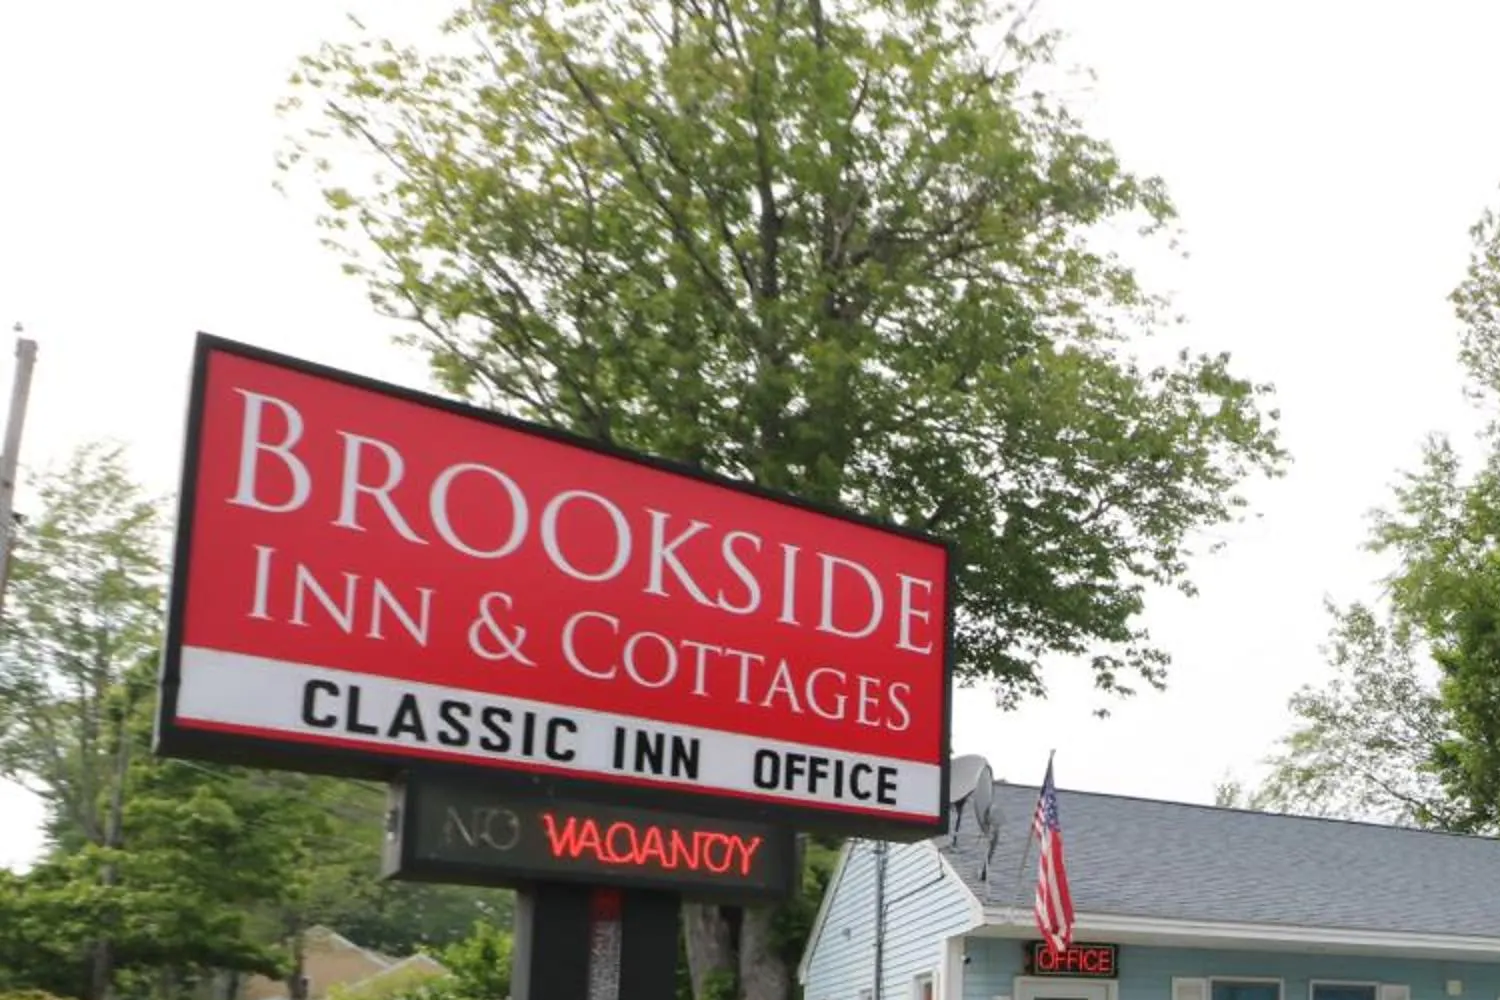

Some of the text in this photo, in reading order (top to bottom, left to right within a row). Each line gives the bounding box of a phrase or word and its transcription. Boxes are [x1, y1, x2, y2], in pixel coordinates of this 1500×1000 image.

[227, 388, 934, 655] BROOKSIDE
[247, 545, 912, 732] INN & COTTAGES
[301, 679, 898, 805] CLASSIC INN OFFICE
[446, 807, 760, 876] NO VACANCY
[1038, 948, 1112, 971] OFFICE
